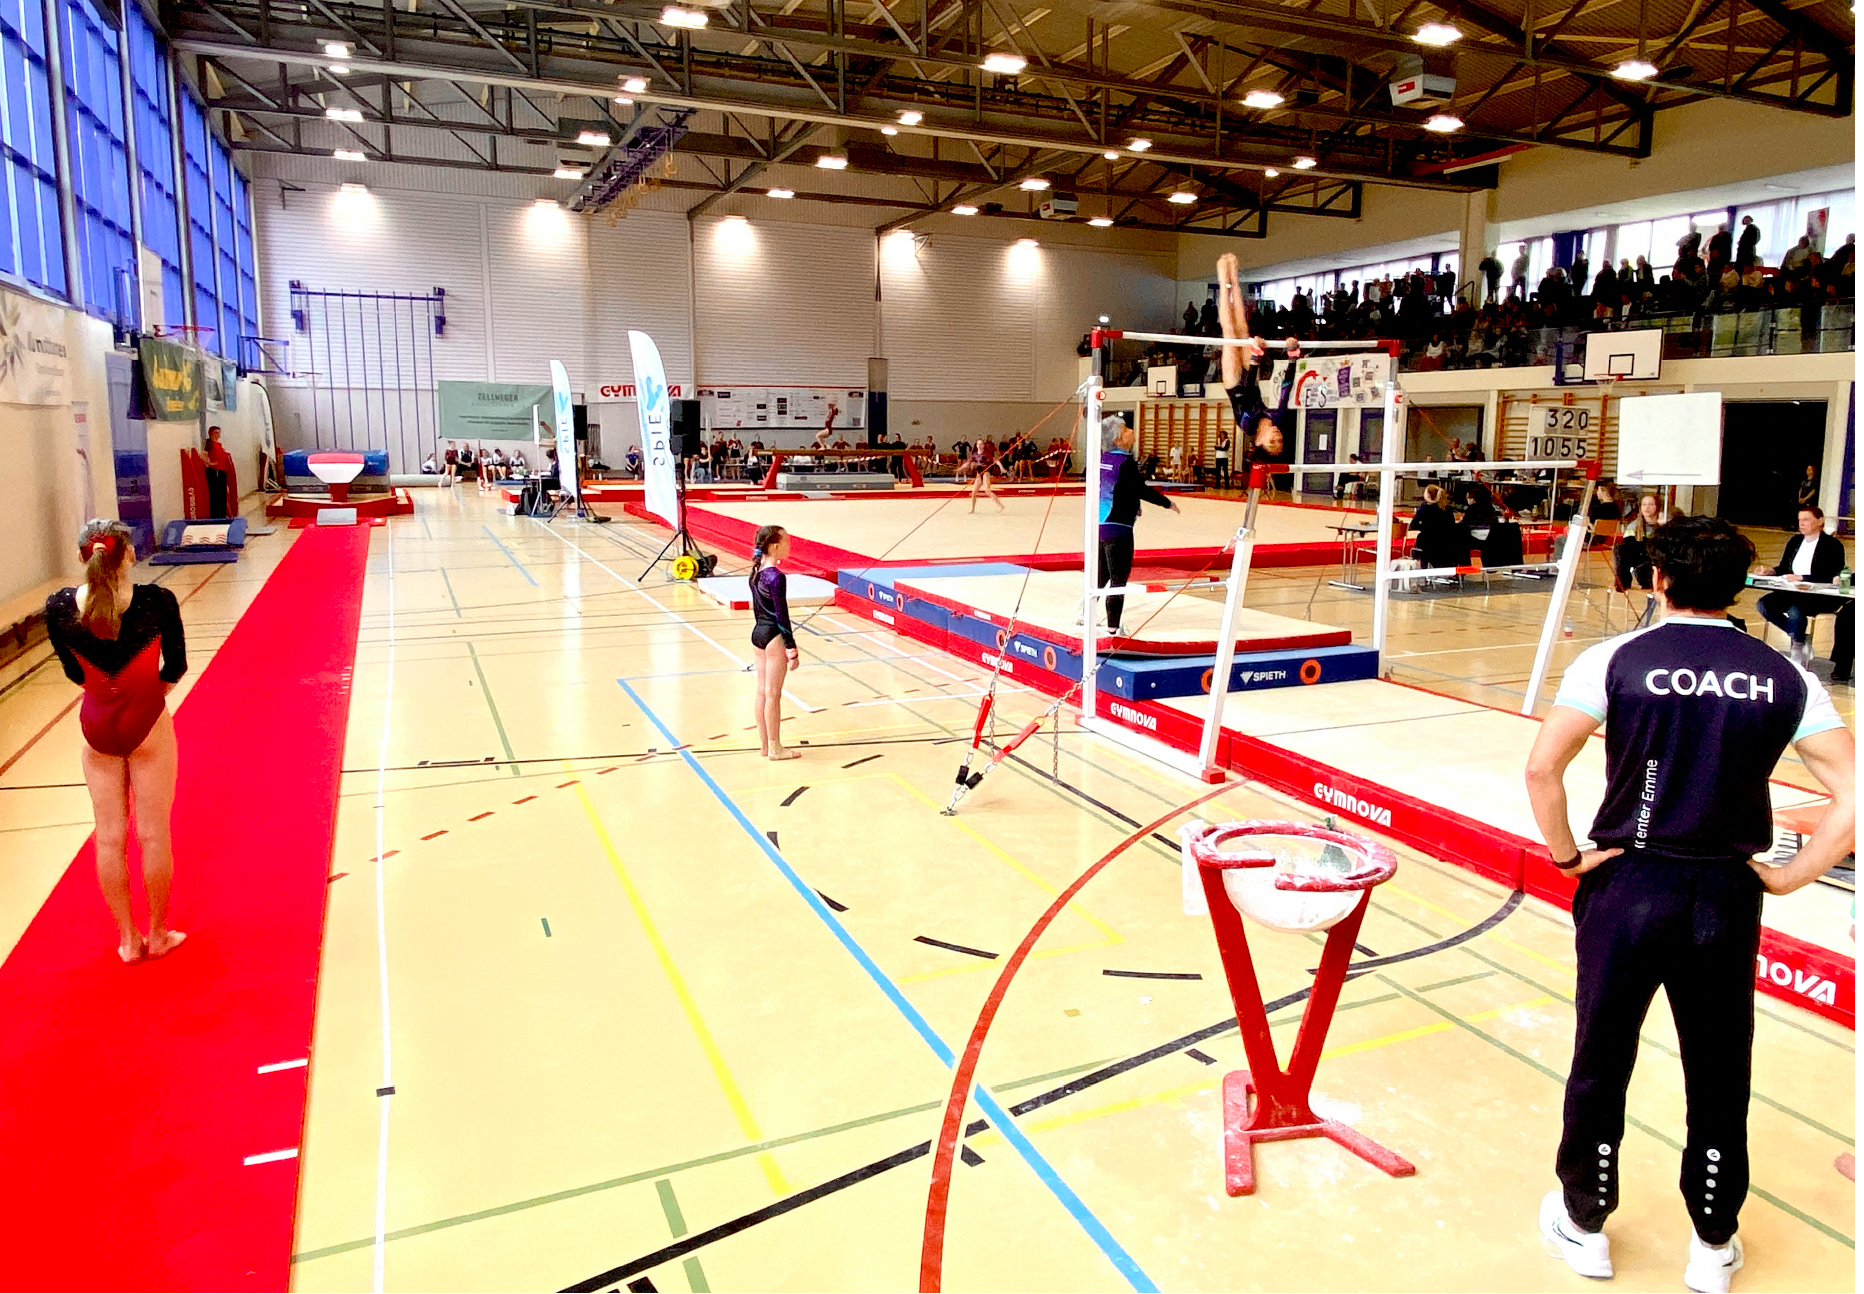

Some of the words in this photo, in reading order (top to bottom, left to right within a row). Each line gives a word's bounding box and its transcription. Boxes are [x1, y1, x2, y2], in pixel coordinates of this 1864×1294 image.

[1547, 408, 1589, 430] 320
[1531, 437, 1587, 458] 1055
[1252, 670, 1287, 682] SPIETH
[1645, 668, 1774, 704] COACH
[1110, 702, 1157, 731] GYMNOVA
[1641, 759, 1659, 802] Emme
[1313, 782, 1392, 828] GYMNOVA
[1756, 954, 1837, 1005] NOVA
